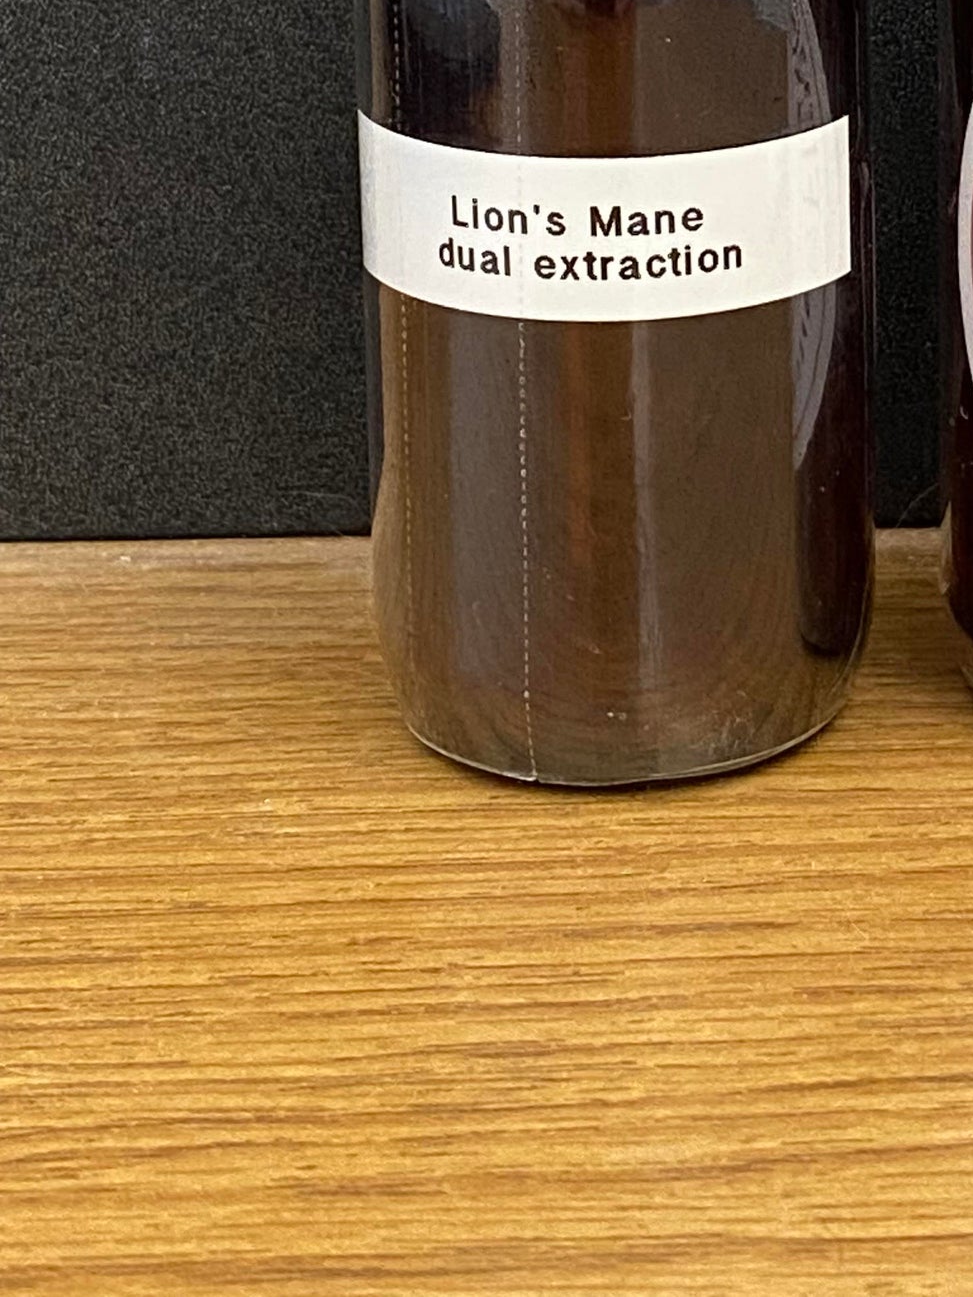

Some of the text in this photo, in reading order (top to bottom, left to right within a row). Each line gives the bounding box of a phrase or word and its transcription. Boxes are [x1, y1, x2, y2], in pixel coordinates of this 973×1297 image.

[450, 194, 704, 238] Lion's Mane
[438, 237, 743, 281] dual extraction
